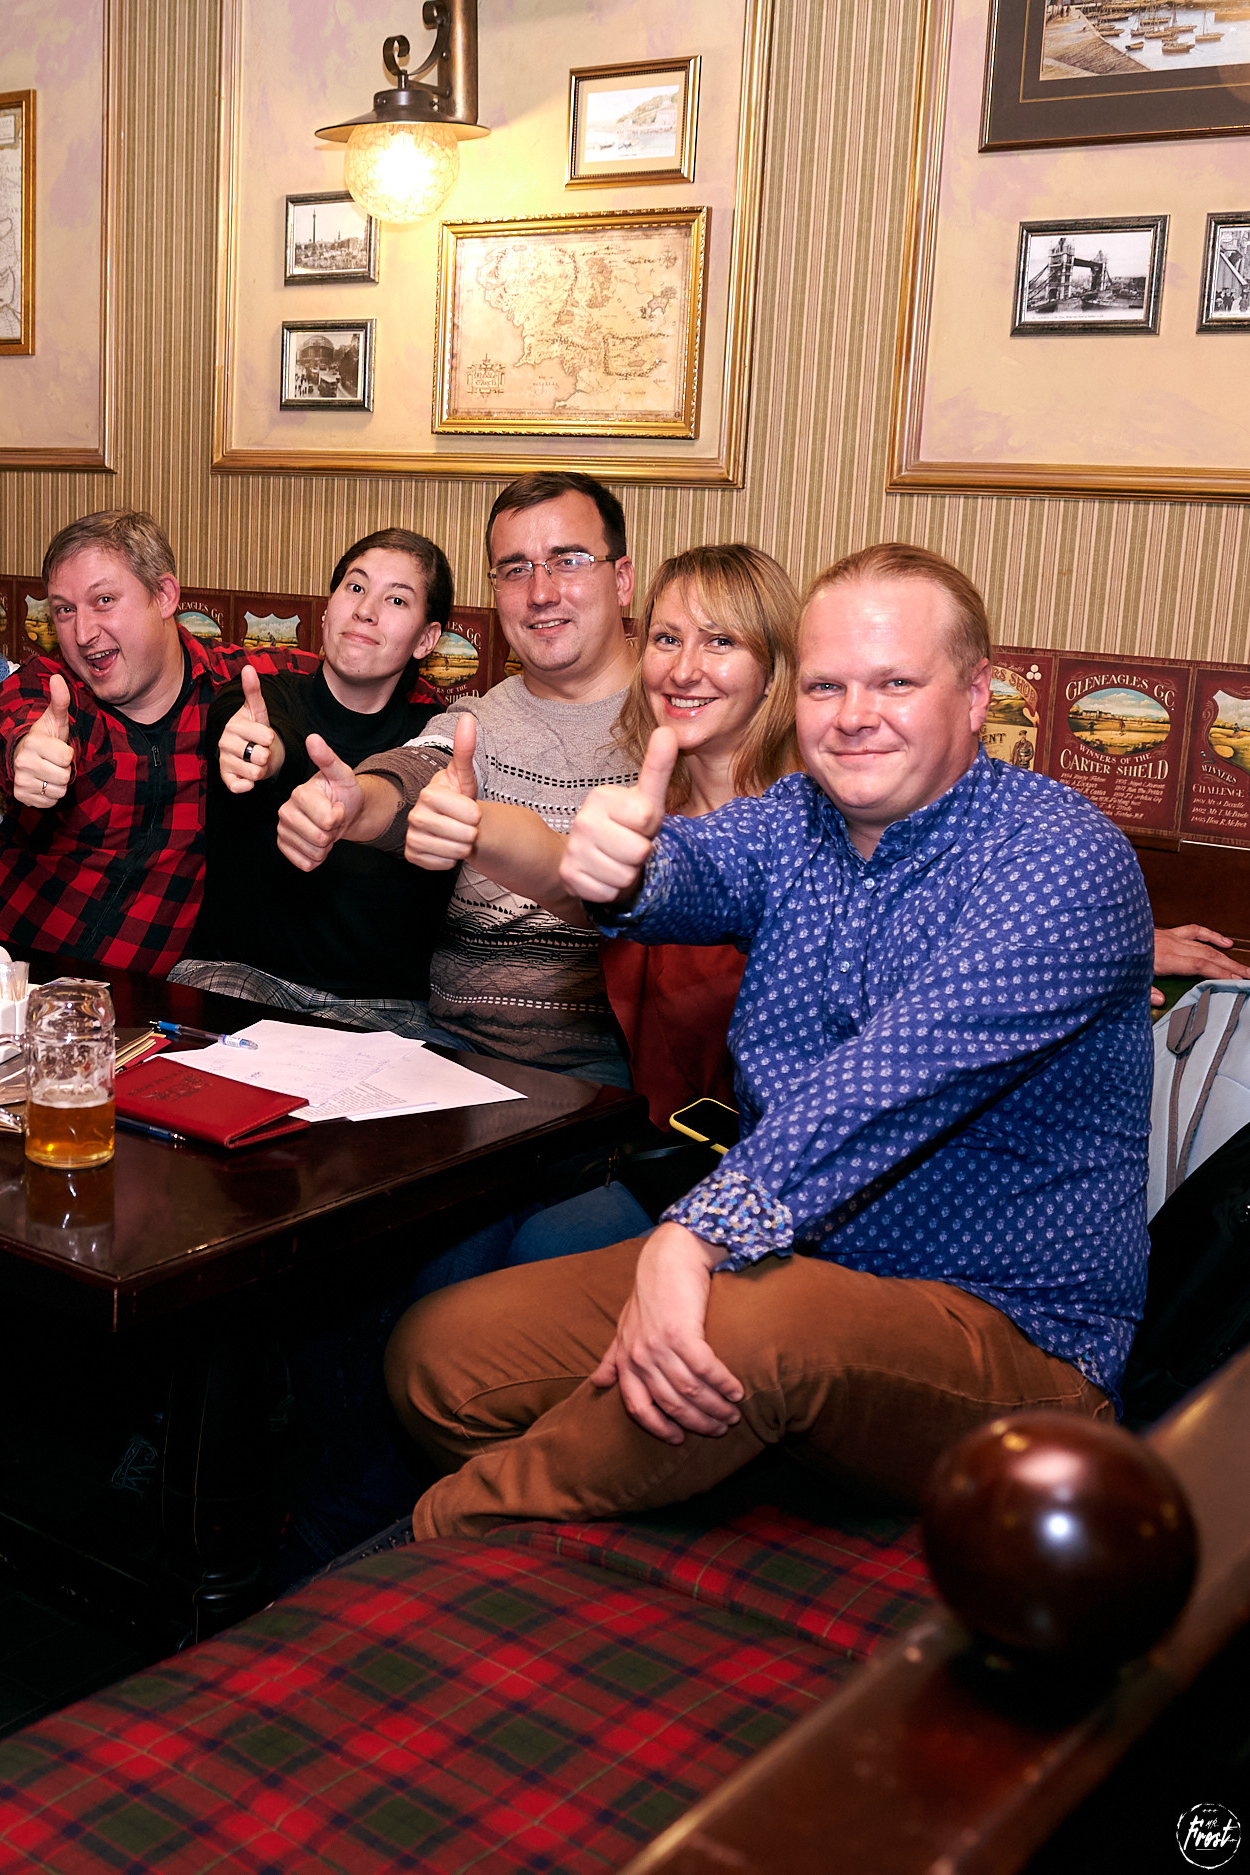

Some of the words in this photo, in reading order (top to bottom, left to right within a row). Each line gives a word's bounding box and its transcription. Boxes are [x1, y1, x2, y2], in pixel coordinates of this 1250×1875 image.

[1065, 674, 1149, 701] GLENEAGLES
[1060, 748, 1110, 774] CARTER
[1116, 759, 1169, 780] SHIELD
[1080, 744, 1116, 764] WINNERS
[1120, 757, 1131, 765] OF
[1134, 752, 1152, 763] THE
[1201, 764, 1238, 784] WINNERS
[1192, 783, 1245, 798] CHALLENGE
